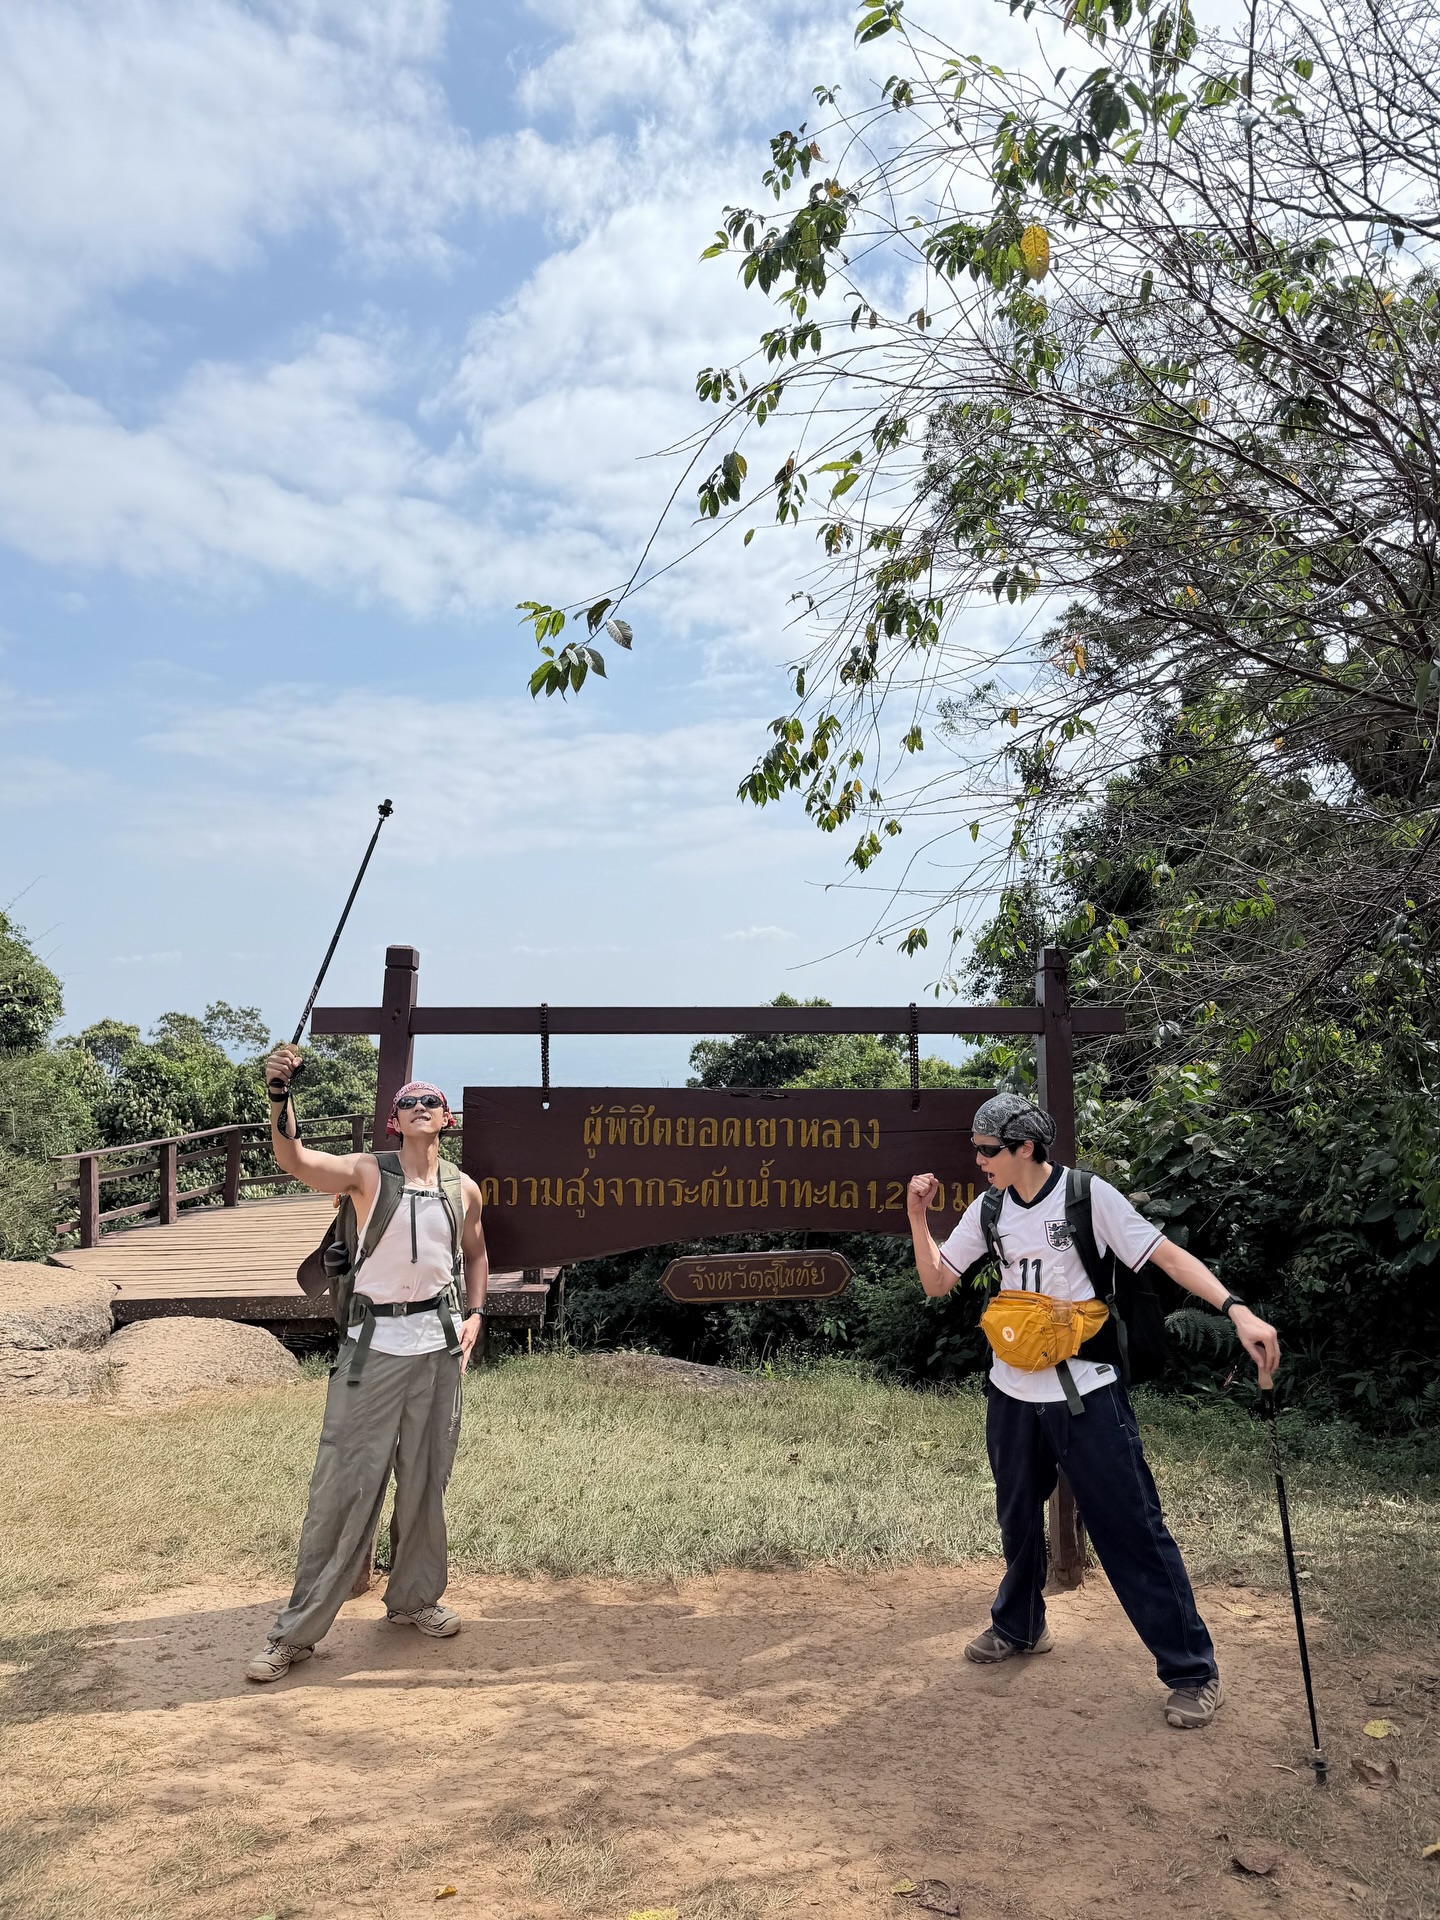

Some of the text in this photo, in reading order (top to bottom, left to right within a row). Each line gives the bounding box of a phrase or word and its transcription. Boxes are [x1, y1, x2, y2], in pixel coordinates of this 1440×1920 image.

[583, 1104, 880, 1159] ผู้พิชิตยอดเขาหลวง
[867, 1181, 945, 1214] 1,20
[689, 1260, 826, 1295] จังหวัดสุโขทัย
[1019, 1258, 1042, 1293] 11
